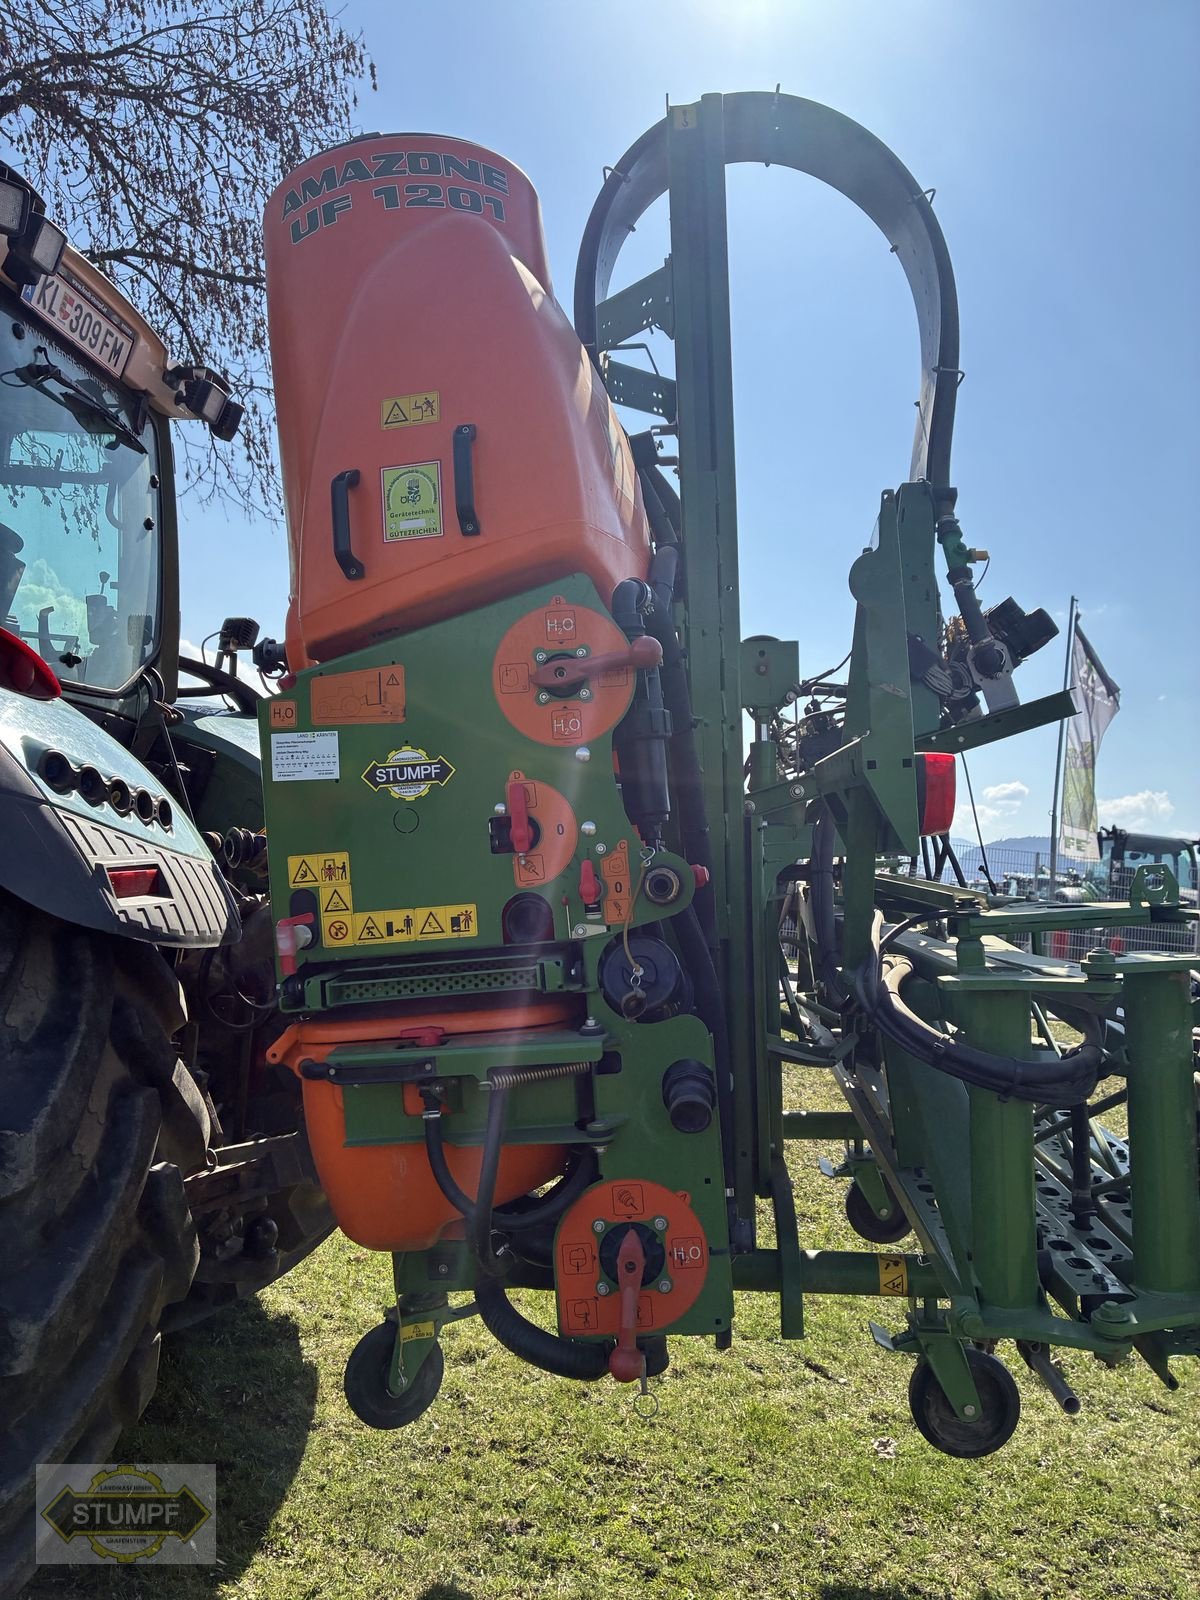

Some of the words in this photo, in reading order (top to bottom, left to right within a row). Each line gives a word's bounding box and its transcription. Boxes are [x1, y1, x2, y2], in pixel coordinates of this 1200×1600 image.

[281, 151, 509, 223] AMAZONE
[290, 194, 352, 244] UF
[373, 184, 505, 222] 1201
[37, 275, 59, 317] KL
[389, 507, 435, 519] Gerätetechnik
[375, 764, 441, 783] STUMPF
[513, 771, 521, 780] D
[556, 823, 565, 836] 0
[619, 841, 627, 850] C
[614, 881, 623, 894] 0
